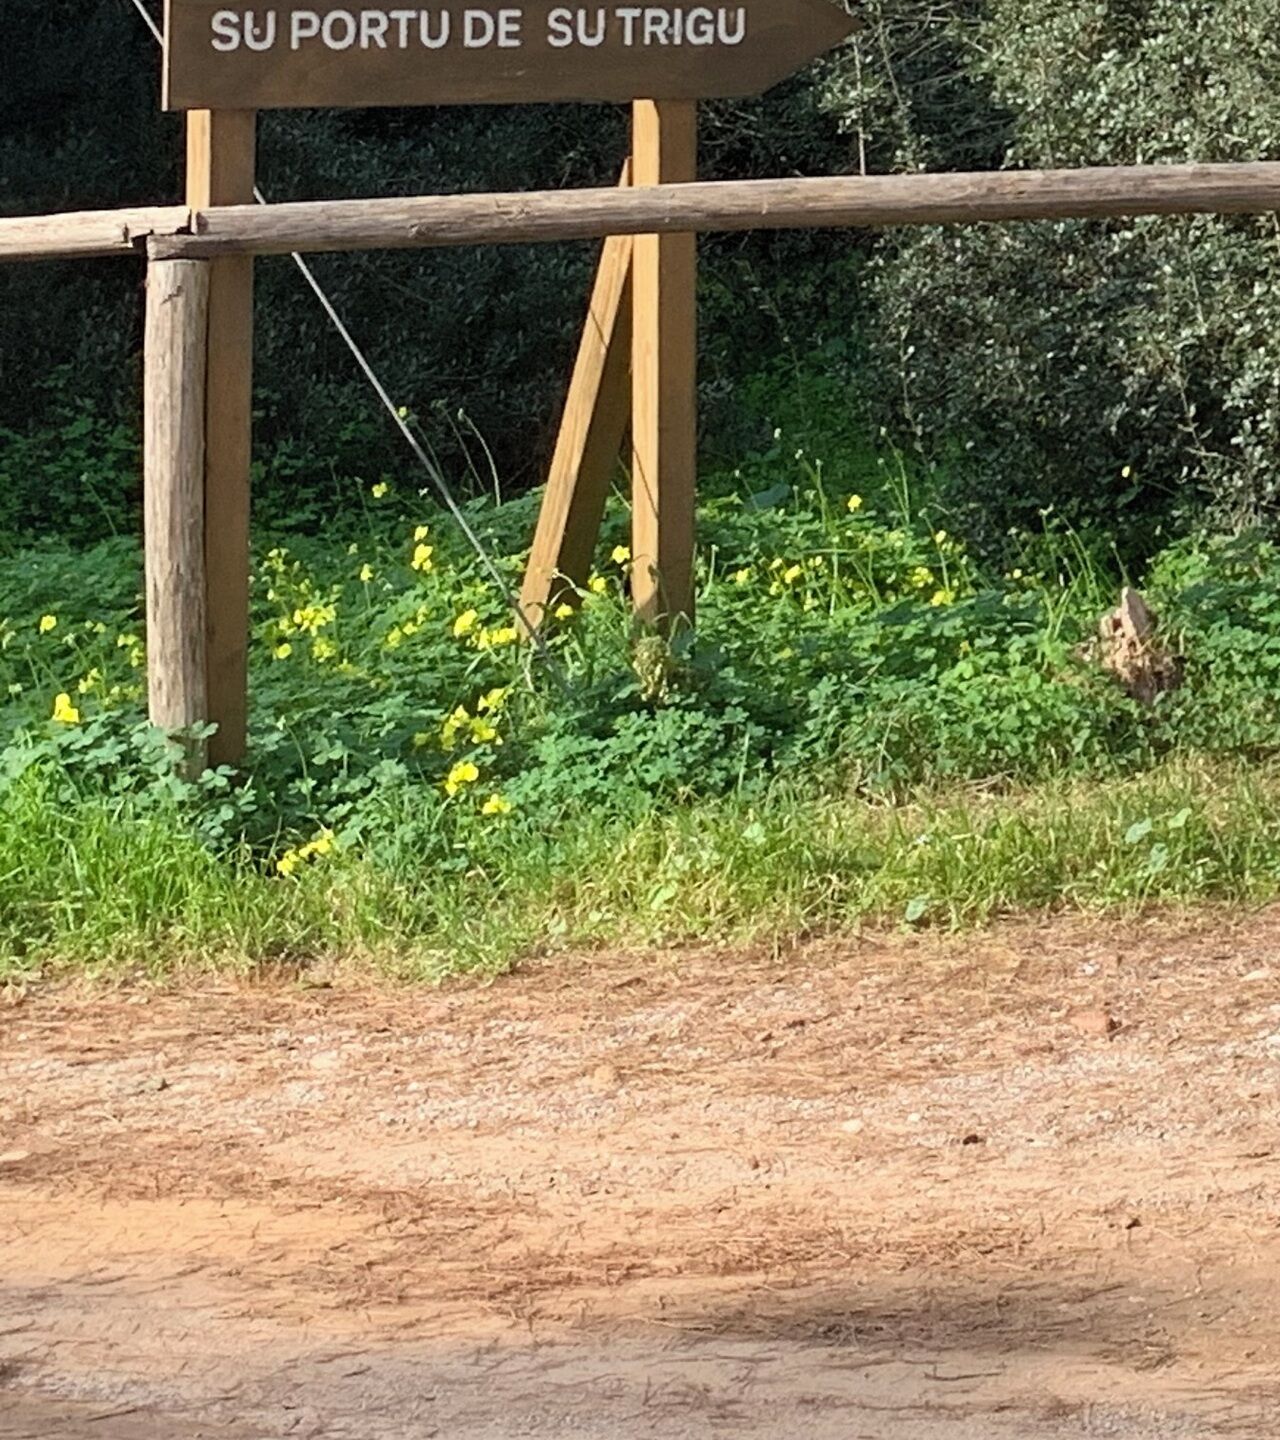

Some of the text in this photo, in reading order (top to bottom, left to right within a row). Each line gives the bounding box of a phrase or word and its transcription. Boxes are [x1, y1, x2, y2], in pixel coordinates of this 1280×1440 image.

[210, 7, 745, 51] SU PORTU DE SU TRIGU
